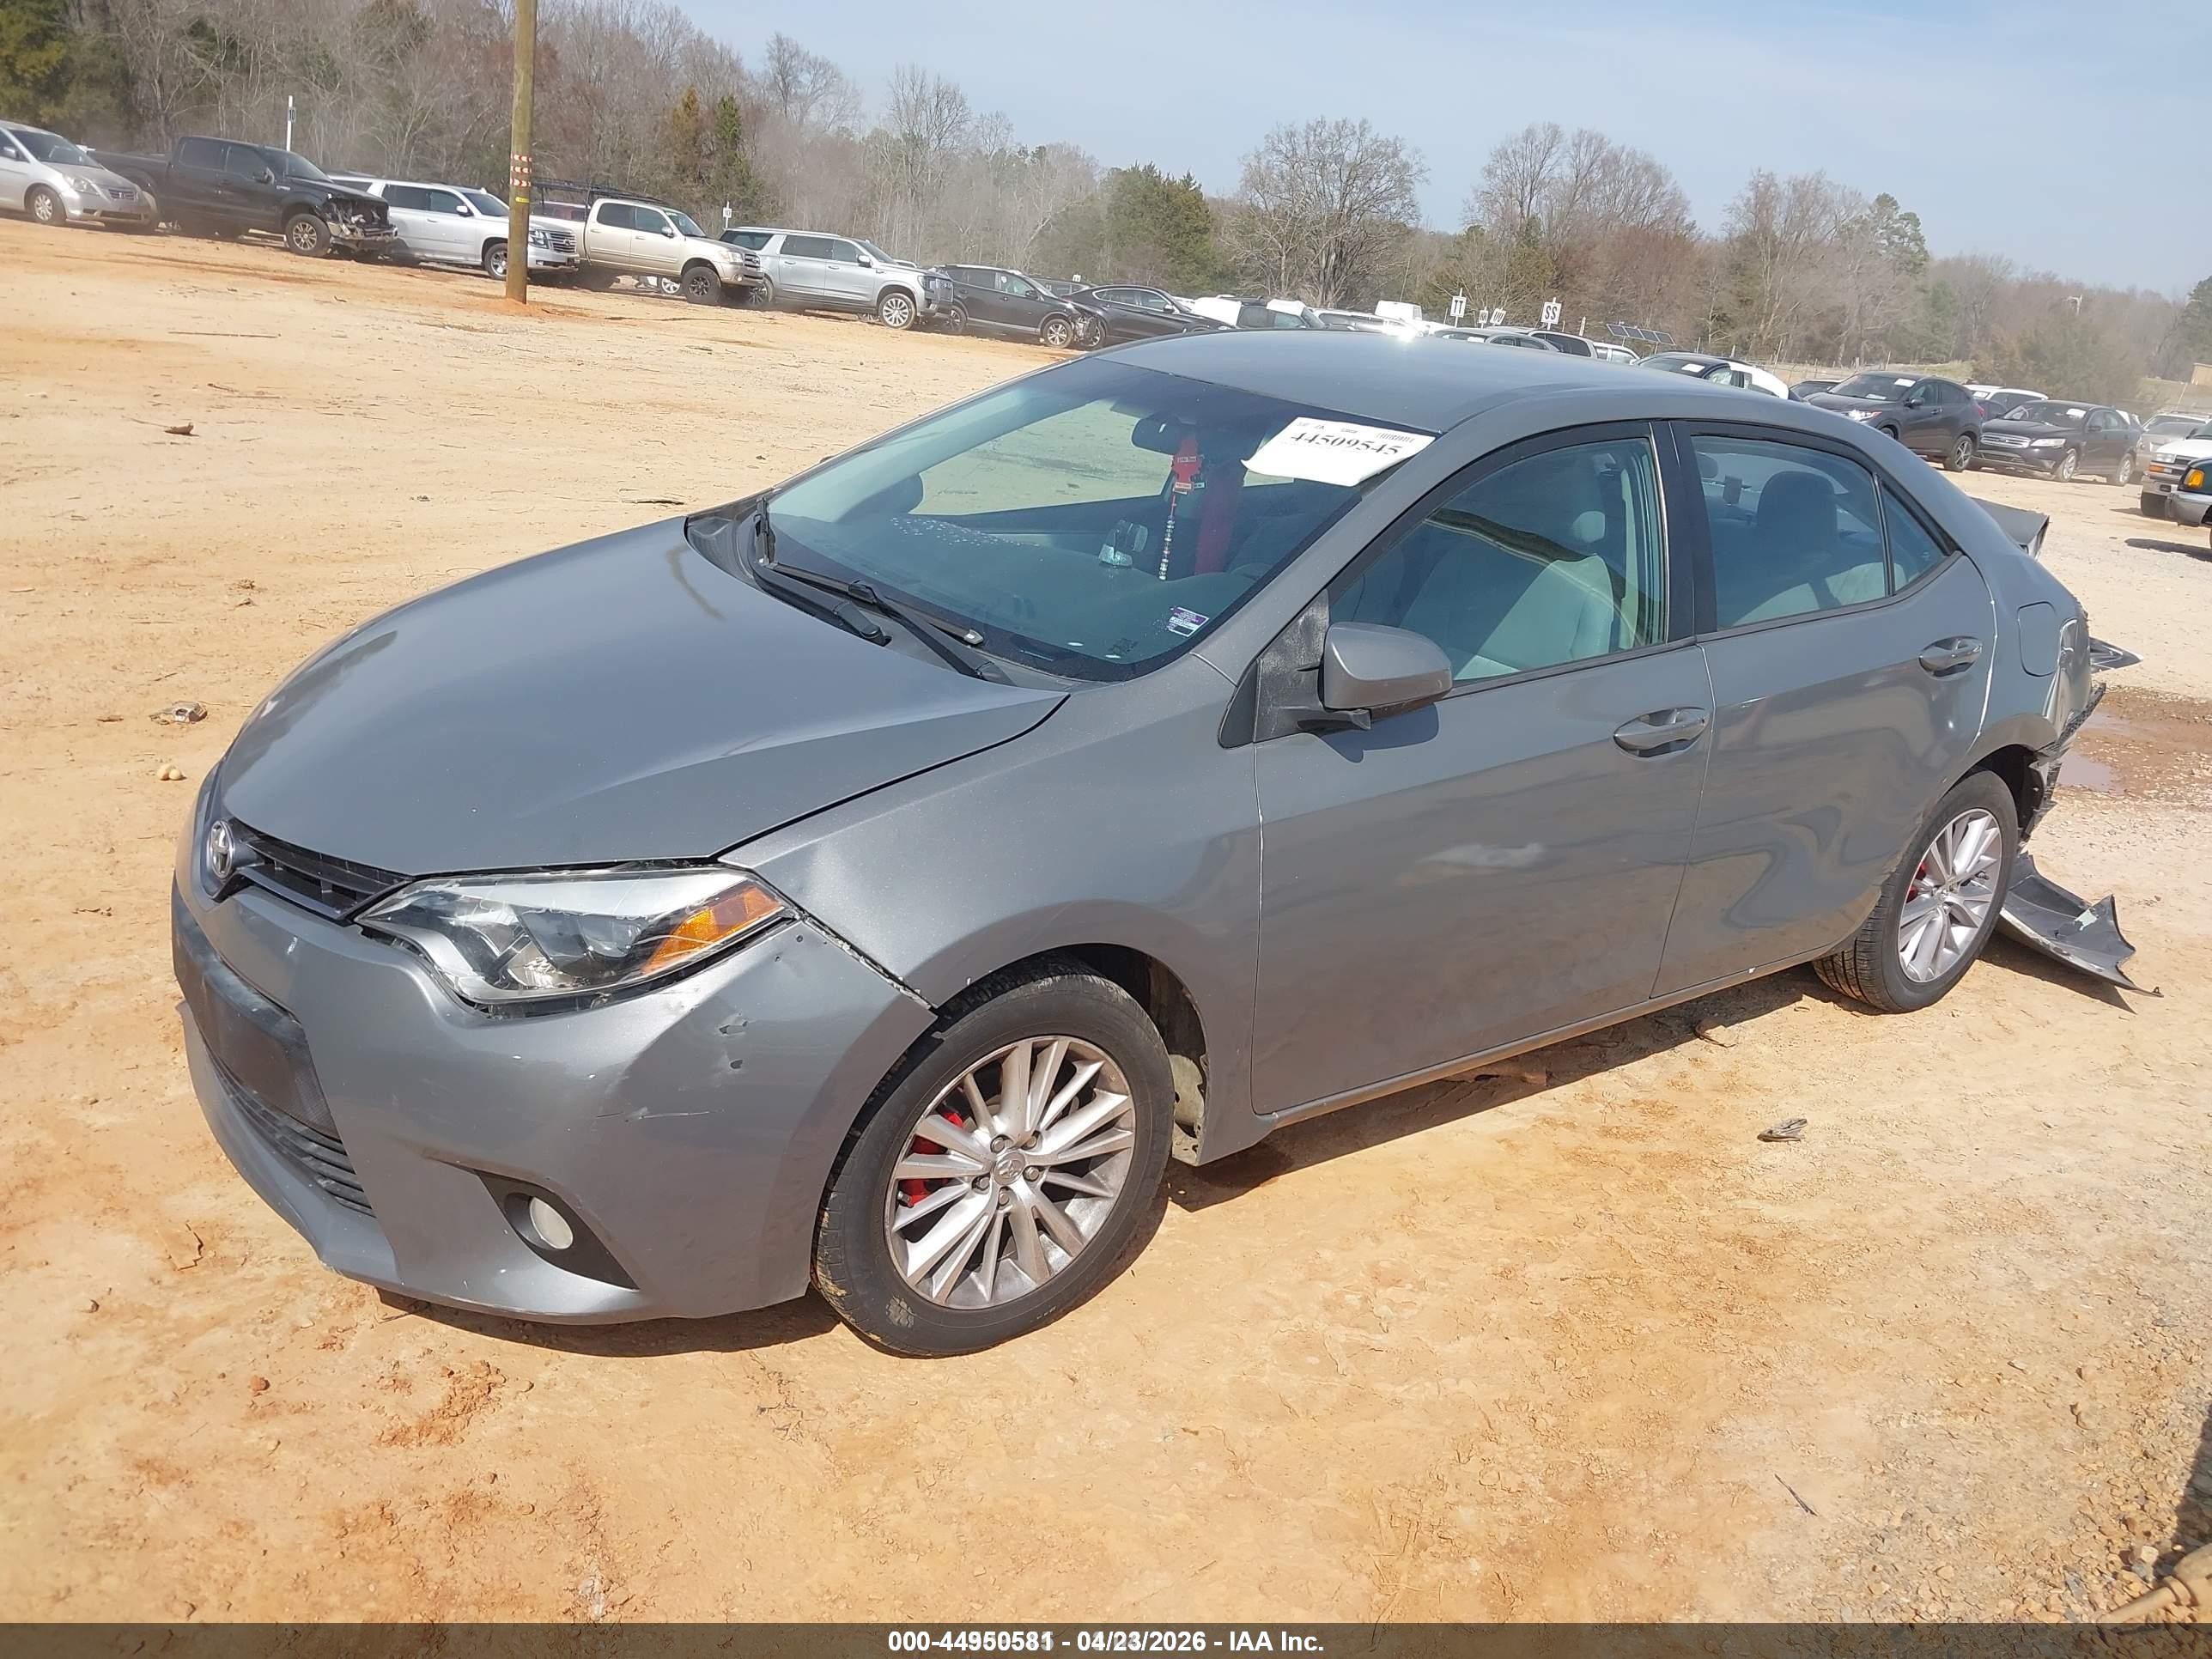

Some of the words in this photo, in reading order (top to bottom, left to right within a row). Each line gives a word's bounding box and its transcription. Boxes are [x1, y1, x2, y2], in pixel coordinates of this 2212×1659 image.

[1453, 300, 1464, 315] TT
[1545, 305, 1558, 320] SS
[1291, 432, 1403, 454] 44509545
